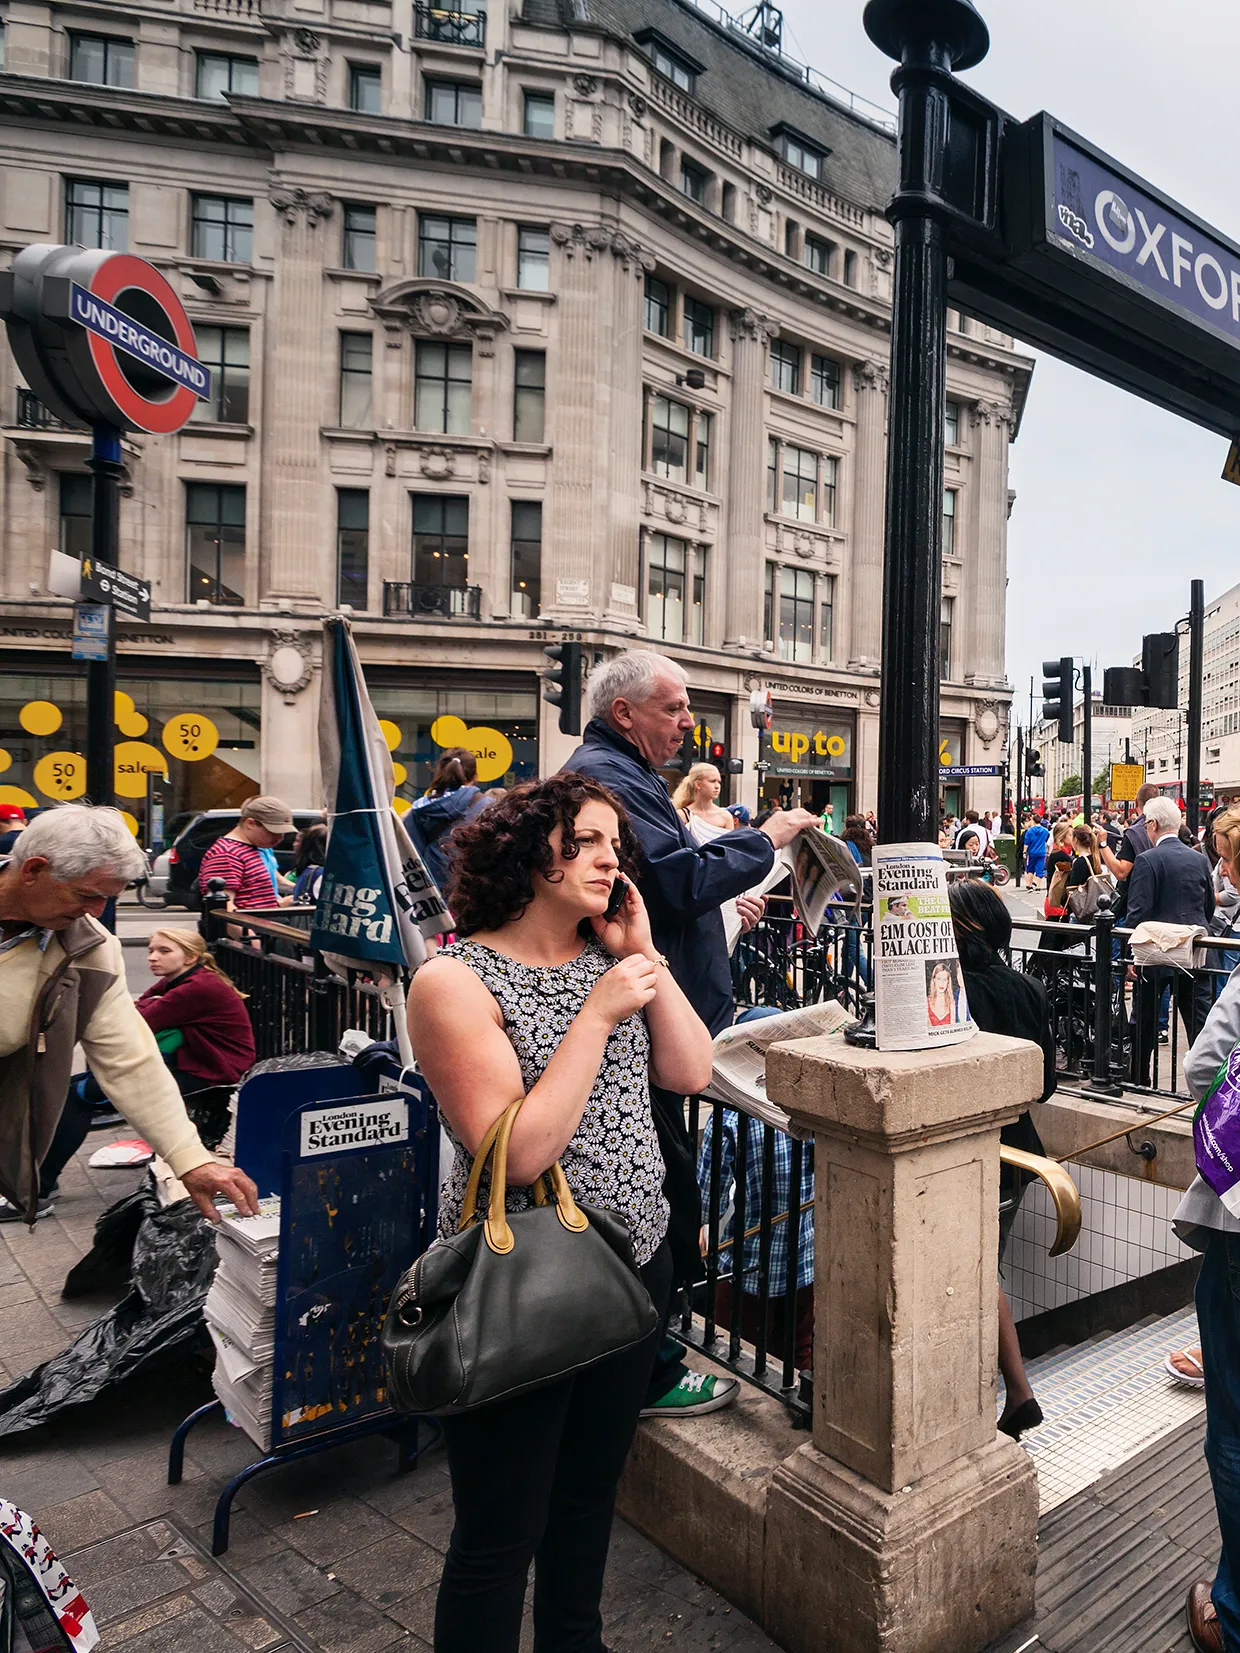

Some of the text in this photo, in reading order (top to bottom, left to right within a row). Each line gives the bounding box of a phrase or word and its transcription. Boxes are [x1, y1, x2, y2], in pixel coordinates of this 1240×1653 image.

[76, 294, 206, 388] UNDERGROUND
[95, 562, 139, 591] Bond Street
[111, 585, 138, 605] Station
[43, 630, 73, 639] COLO
[117, 633, 175, 645] ENETTON.
[765, 681, 788, 692] UNITED
[788, 684, 814, 695] COLORS
[815, 687, 824, 696] OF
[179, 724, 201, 738] 50
[182, 738, 199, 752] %
[772, 730, 846, 763] up to
[53, 763, 75, 777] 50
[117, 761, 149, 774] sale
[951, 767, 970, 775] CIRCUS
[55, 778, 73, 792] %
[878, 866, 933, 879] Evening
[878, 878, 939, 892] Standard
[918, 897, 936, 905] THE
[918, 906, 940, 914] BEAT
[881, 923, 905, 940] £1M
[908, 922, 938, 938] COST
[881, 938, 931, 957] PALACE
[933, 938, 949, 954] FIT
[322, 1112, 357, 1121] London
[309, 1113, 391, 1135] Evening
[308, 1122, 401, 1150] Standard
